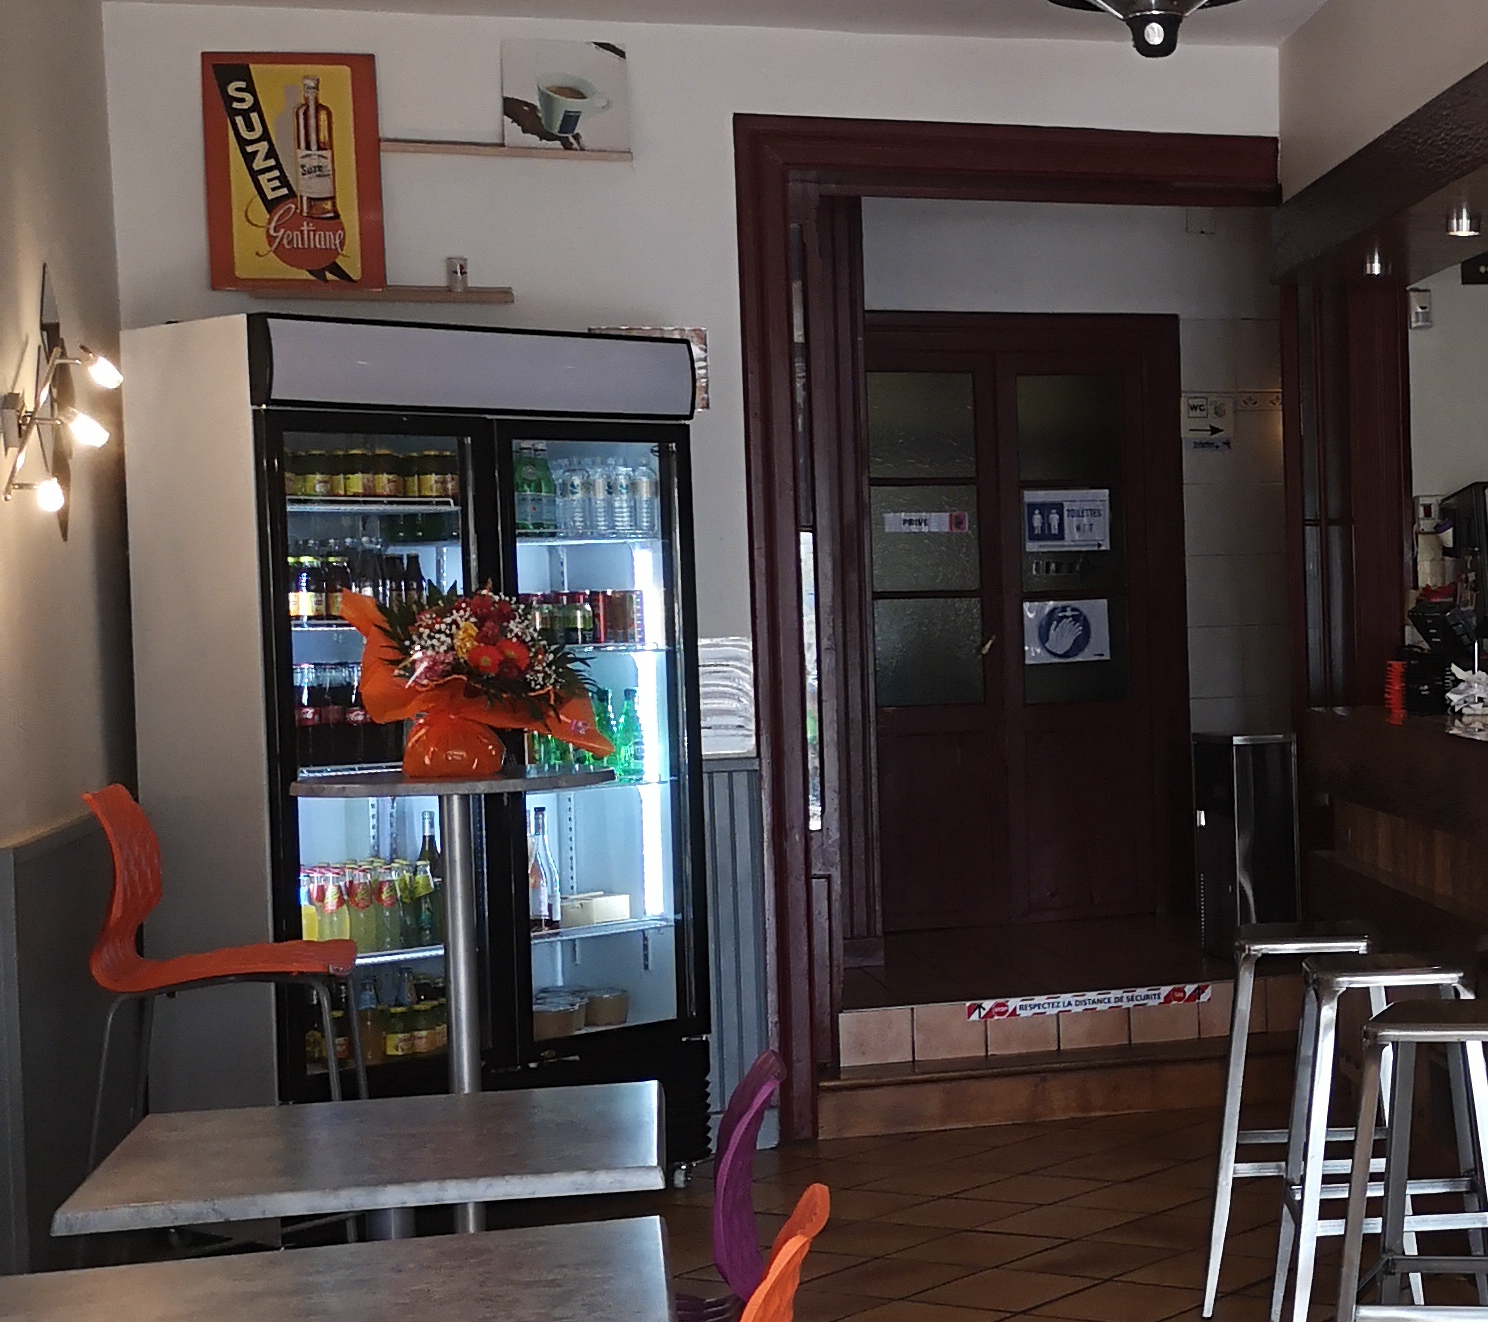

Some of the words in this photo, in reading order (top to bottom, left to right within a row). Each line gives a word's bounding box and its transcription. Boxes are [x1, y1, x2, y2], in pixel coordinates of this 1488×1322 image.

[227, 80, 289, 201] SUZE
[265, 203, 347, 254] Gentiane
[1189, 404, 1206, 412] WC
[1018, 1000, 1061, 1012] RESPECTEZ
[1062, 998, 1073, 1008] LA
[1074, 995, 1112, 1007] DISTANCE
[1113, 994, 1124, 1004] DE
